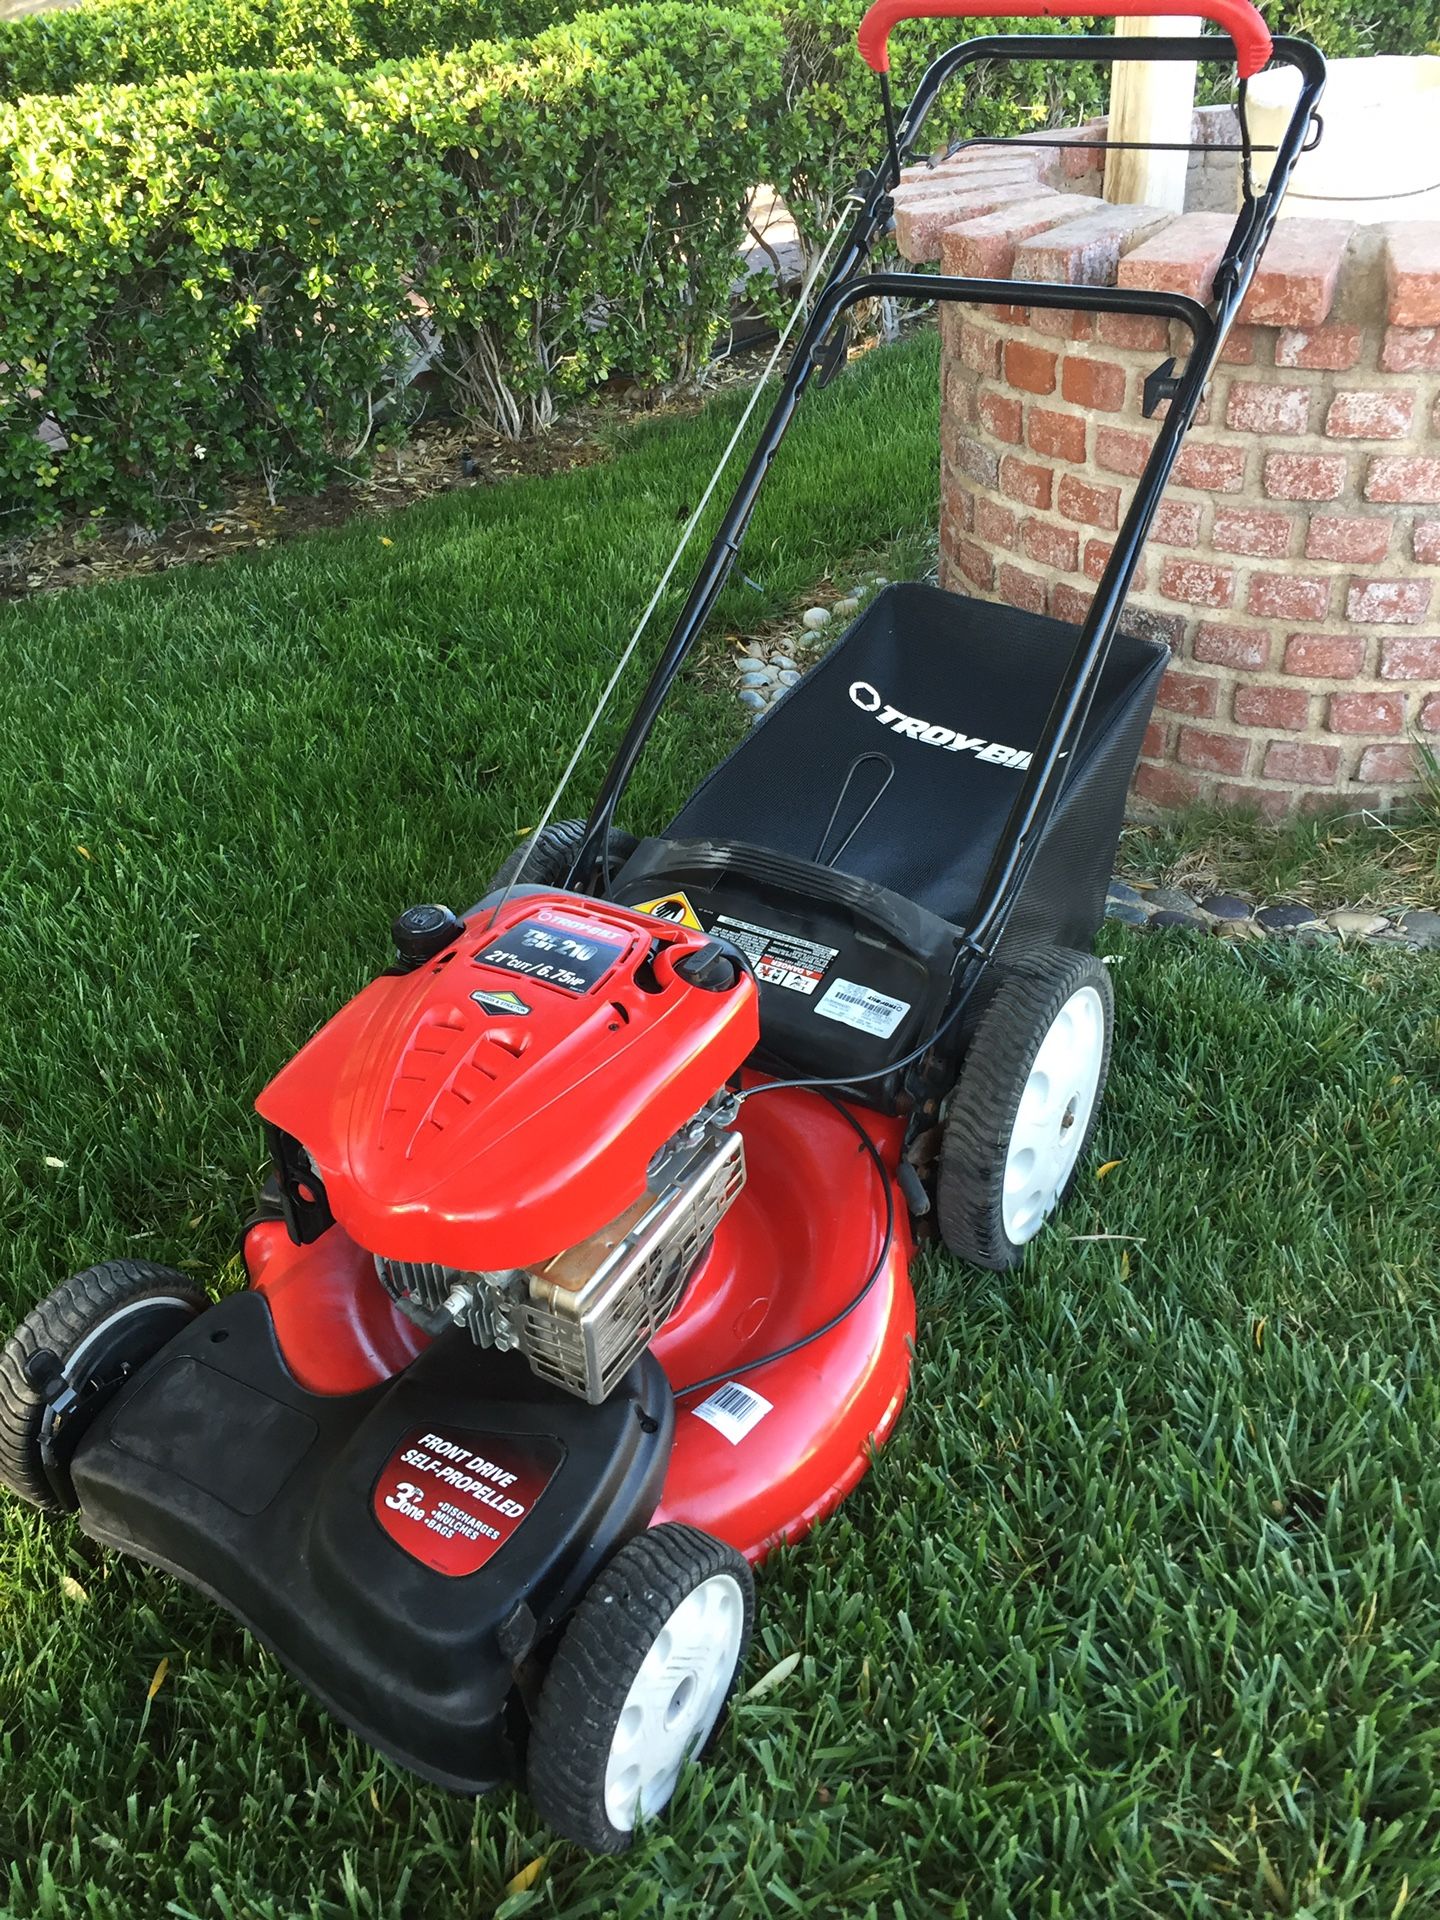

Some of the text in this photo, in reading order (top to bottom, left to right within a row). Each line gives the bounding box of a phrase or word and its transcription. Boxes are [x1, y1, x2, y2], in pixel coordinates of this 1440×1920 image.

[400, 1449, 525, 1519] SELF-PROPELLED
[417, 1433, 518, 1488] FRONT DRIVE
